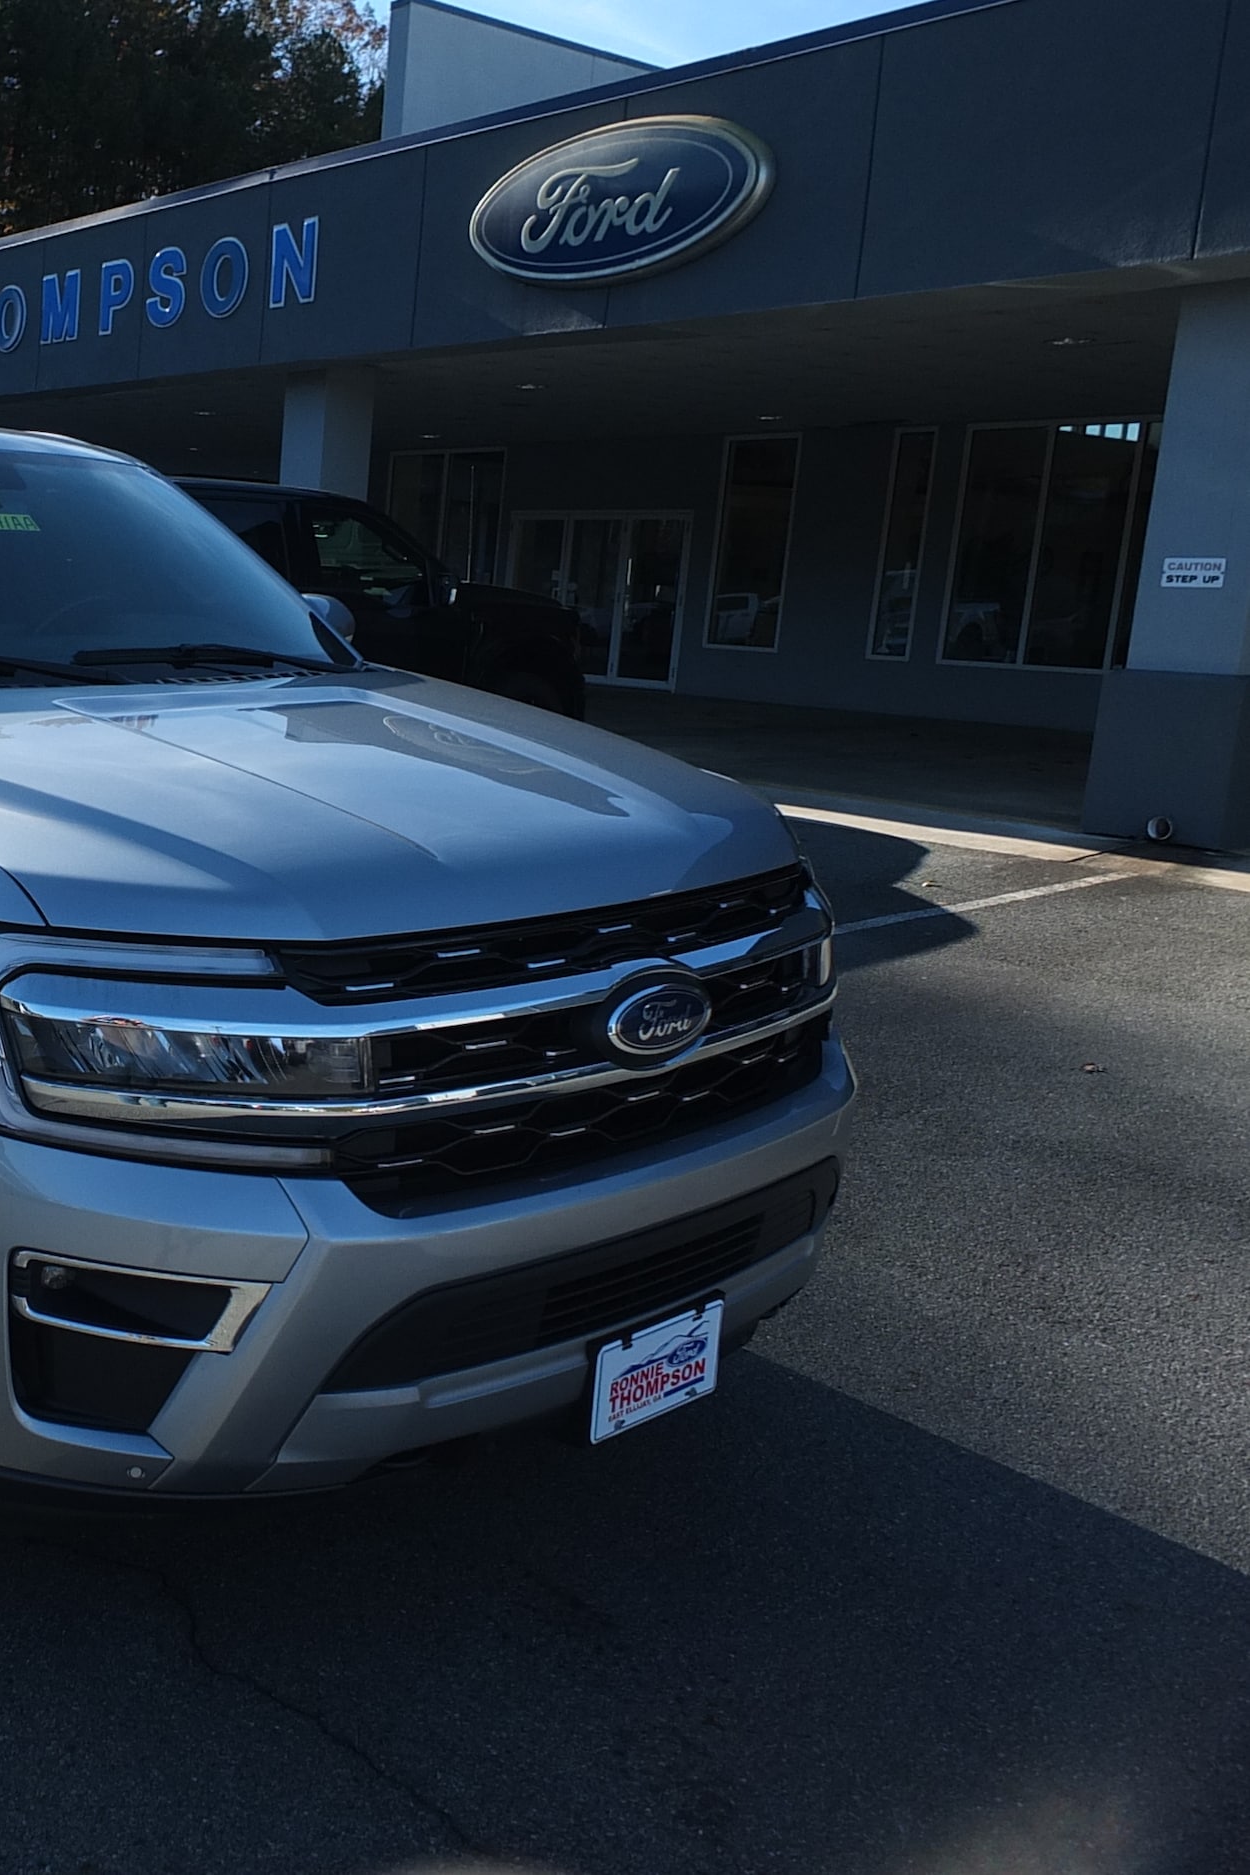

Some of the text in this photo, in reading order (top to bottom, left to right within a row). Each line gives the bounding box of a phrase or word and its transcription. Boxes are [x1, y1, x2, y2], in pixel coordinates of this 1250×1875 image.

[520, 157, 681, 254] Ford
[1165, 574, 1220, 584] STEP UP
[1167, 562, 1222, 571] CAUTION
[638, 1000, 692, 1041] Ford
[672, 1342, 700, 1363] Ford
[608, 1357, 706, 1413] THOMPSON
[609, 1361, 664, 1396] RONNIE
